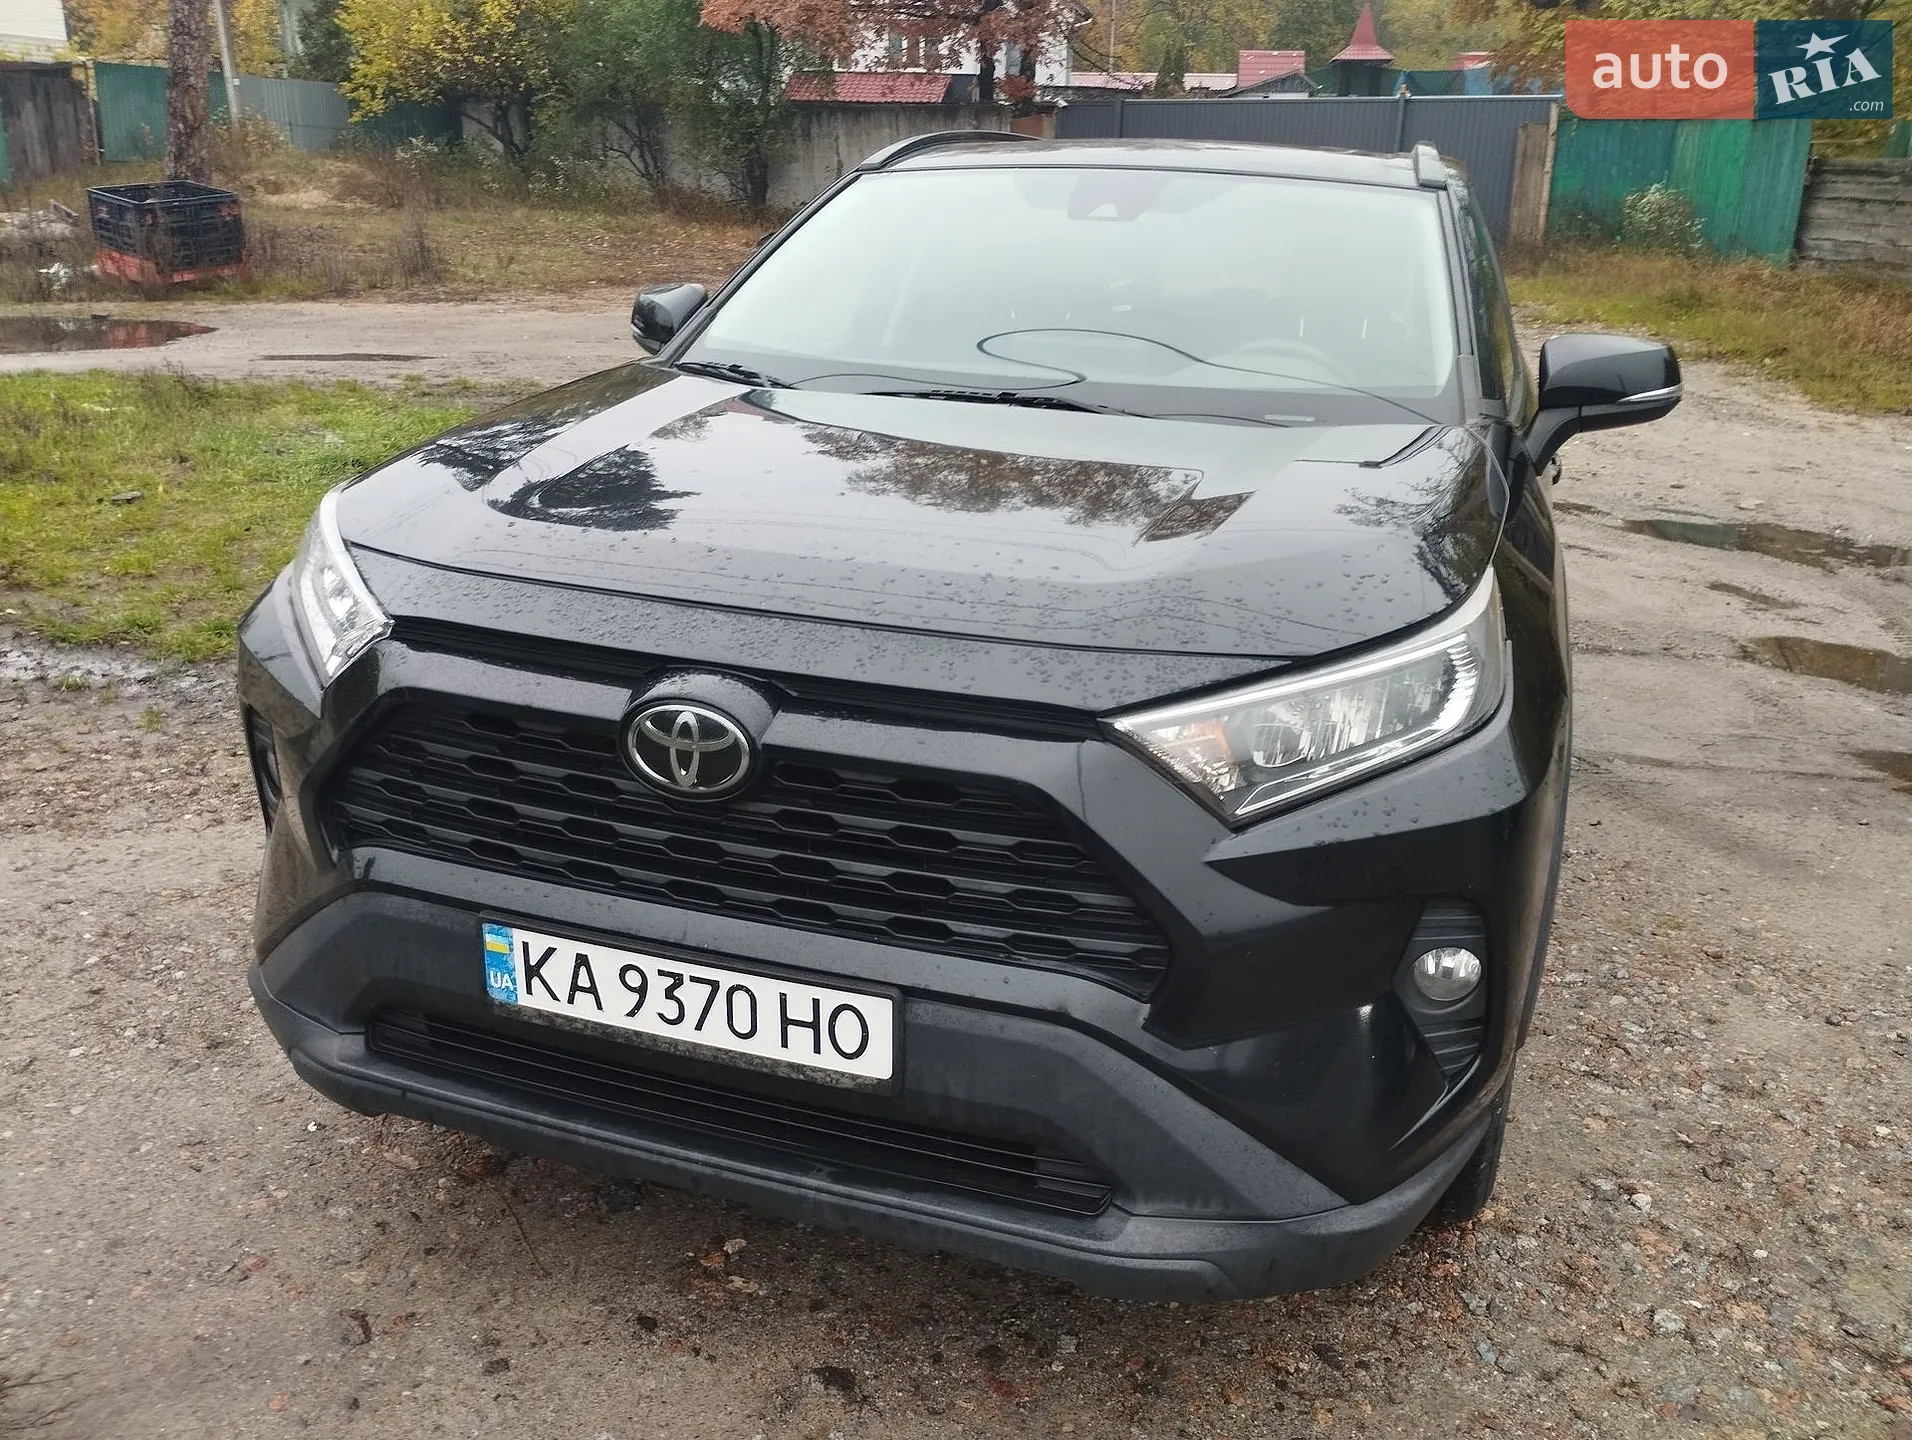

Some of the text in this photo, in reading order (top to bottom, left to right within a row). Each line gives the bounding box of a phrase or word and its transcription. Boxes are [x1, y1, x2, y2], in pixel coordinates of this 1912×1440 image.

[489, 971, 515, 991] UA
[521, 940, 870, 1060] KA 9370 HO
